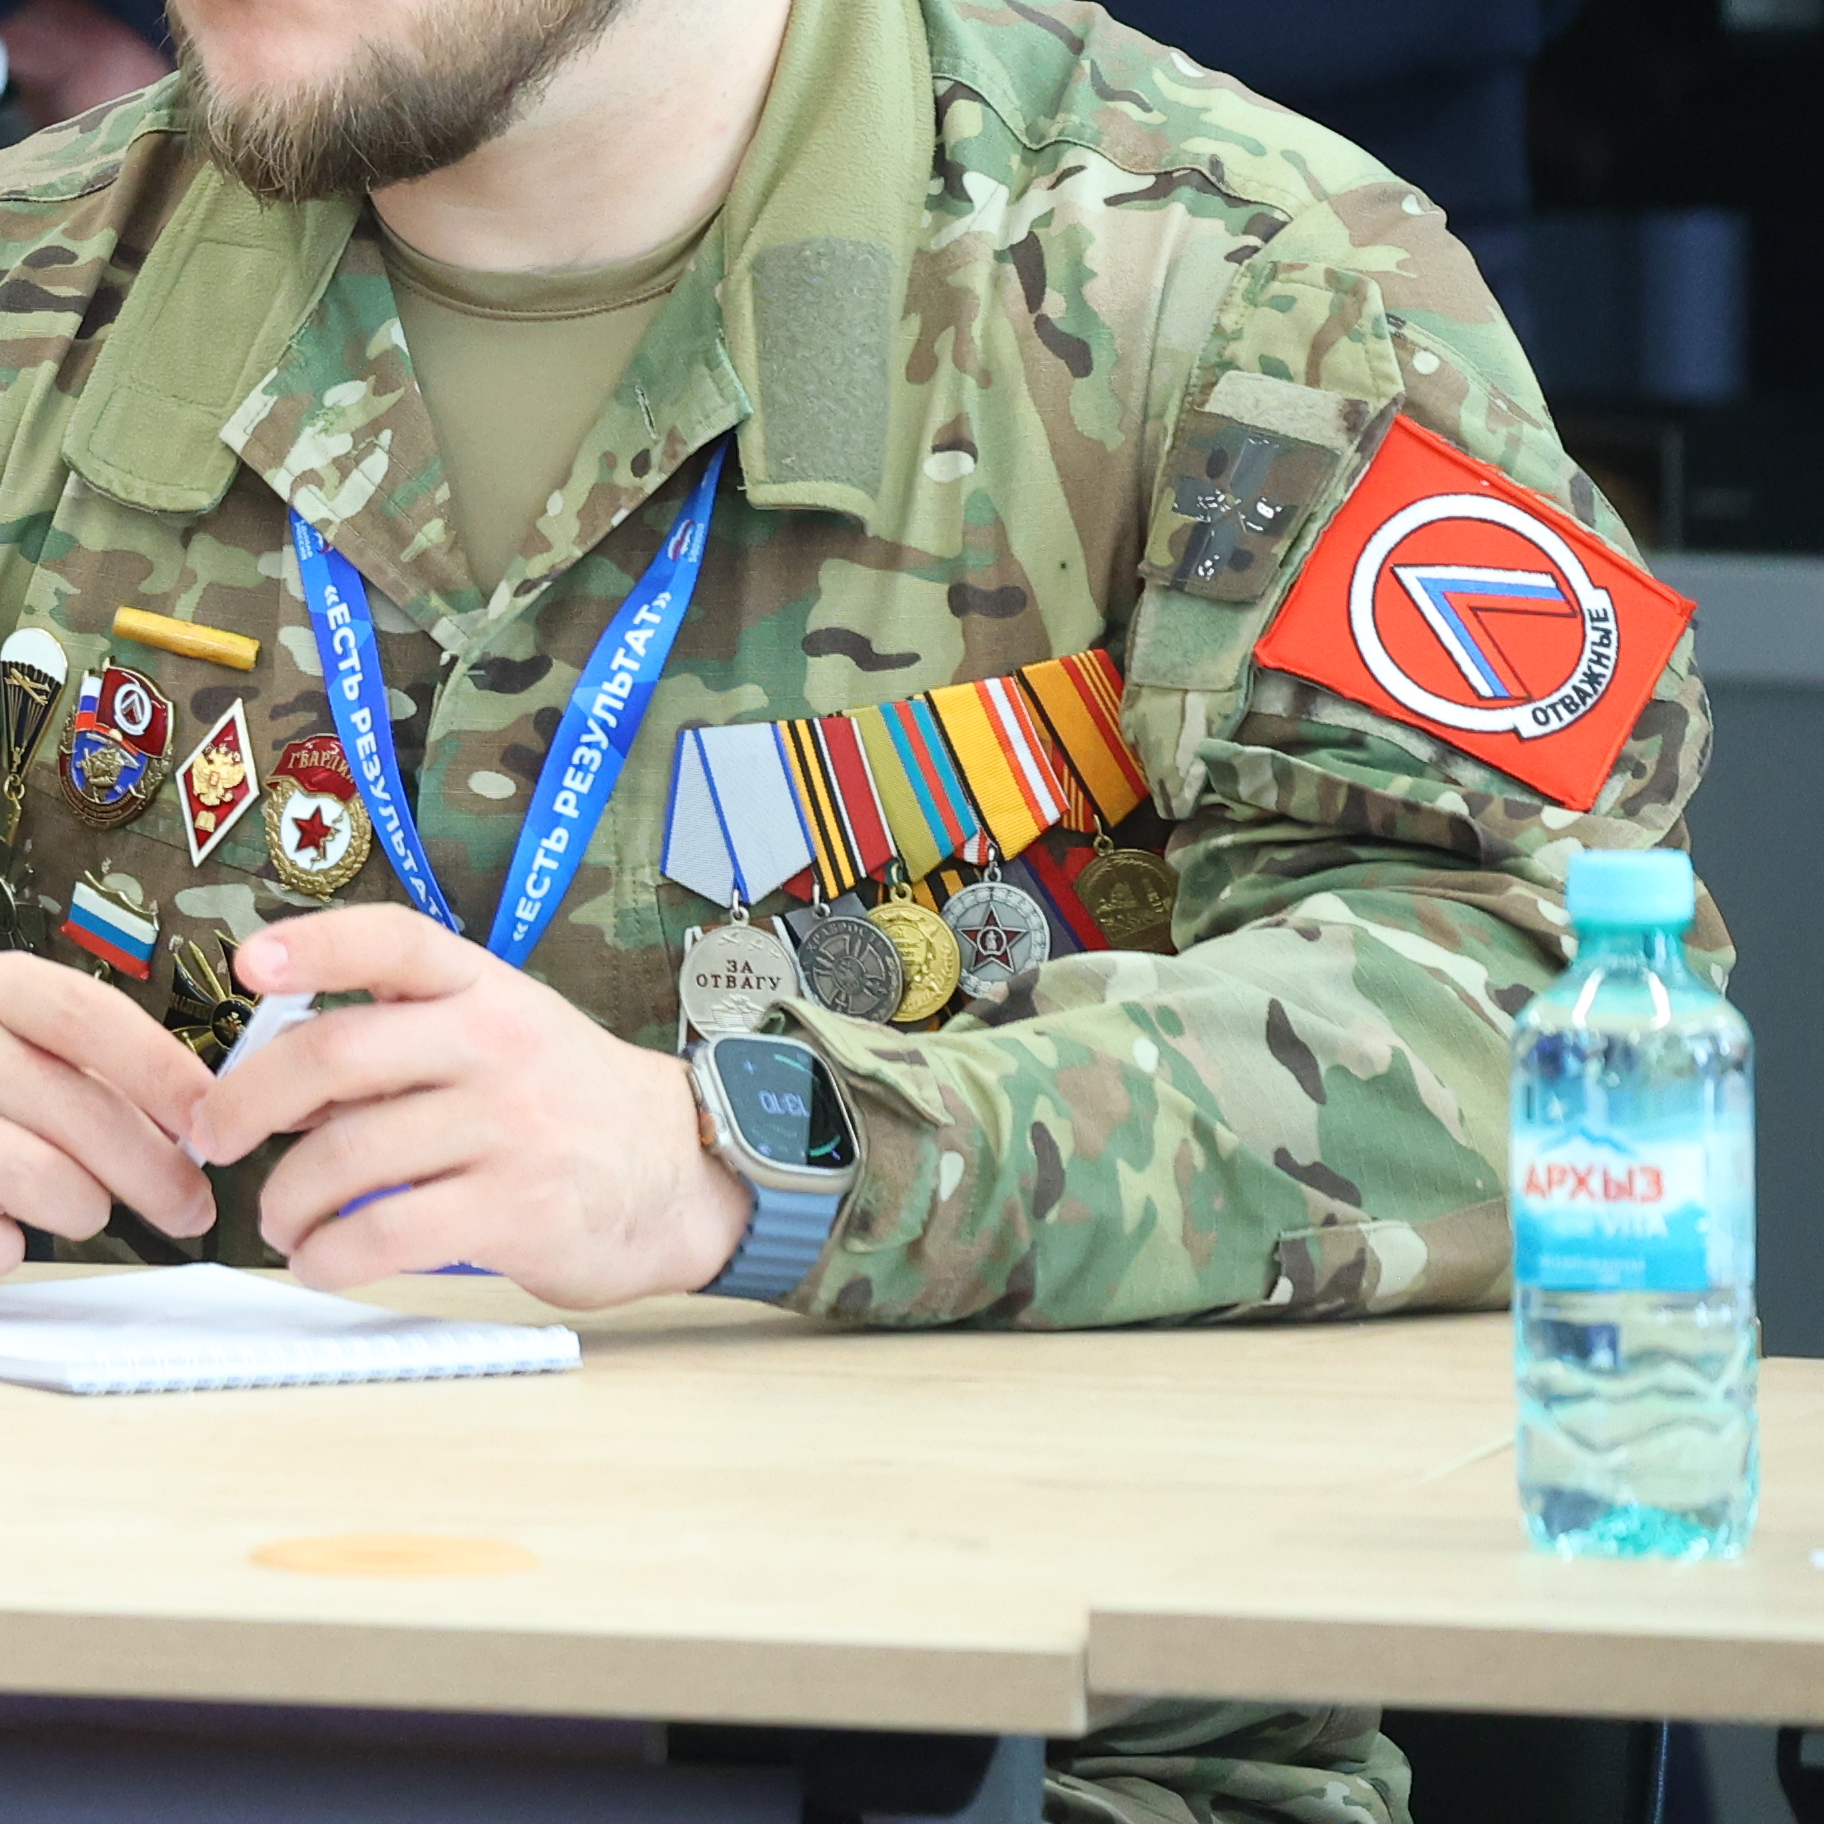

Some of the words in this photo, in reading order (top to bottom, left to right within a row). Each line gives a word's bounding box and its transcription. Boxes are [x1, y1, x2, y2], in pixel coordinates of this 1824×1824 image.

[1531, 606, 1609, 727] ОТВАЖНЫЕ
[324, 584, 362, 701] «ЕСТЬ
[350, 712, 447, 927] РЕЗУЛЬТАТ
[513, 827, 569, 941] «ЕСТЬ
[560, 590, 672, 819] РЕЗУЛЬТАТ»
[696, 972, 782, 991] ОТВАГУ
[725, 959, 755, 974] ЗА
[1523, 1160, 1665, 1203] АРХЫЗ
